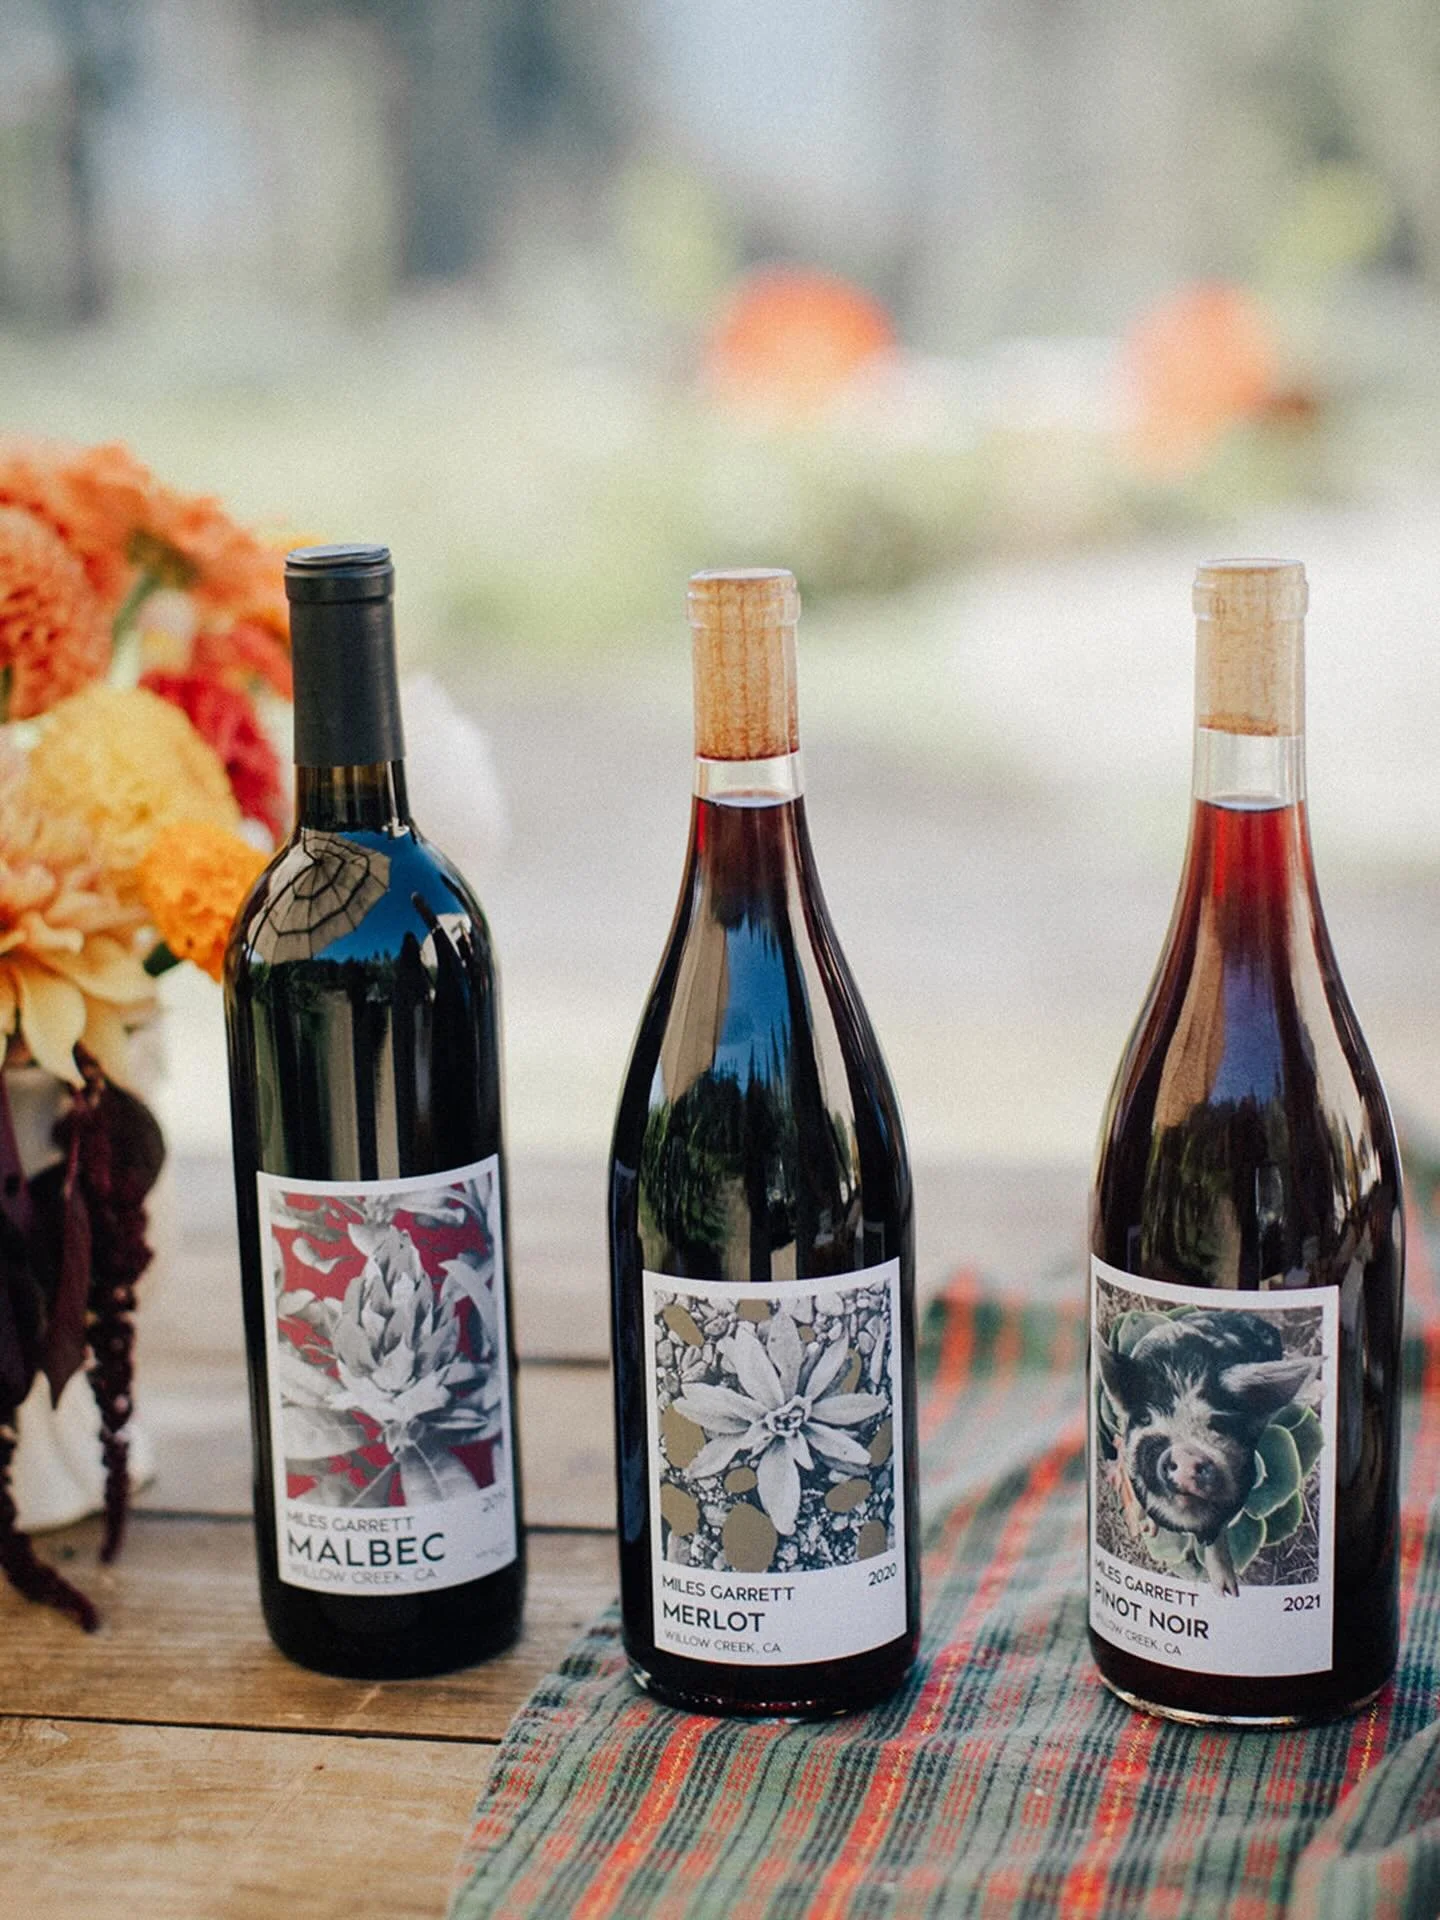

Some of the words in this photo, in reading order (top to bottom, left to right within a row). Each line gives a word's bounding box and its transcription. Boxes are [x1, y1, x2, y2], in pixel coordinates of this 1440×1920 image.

[331, 1516, 415, 1533] GARRETT
[286, 1530, 446, 1568] MALBEC
[414, 1567, 437, 1582] CA
[867, 1562, 898, 1586] 2020
[661, 1575, 706, 1597] MILES
[710, 1585, 796, 1602] GARRETT
[1125, 1575, 1200, 1607] GARRETT
[1095, 1580, 1143, 1622] PINOT
[1149, 1608, 1210, 1641] NOIR
[1283, 1594, 1321, 1612] 2021
[662, 1601, 766, 1633] MERLOT
[664, 1629, 710, 1648] WILLOW
[762, 1642, 782, 1654] CA
[1163, 1641, 1182, 1656] CA
